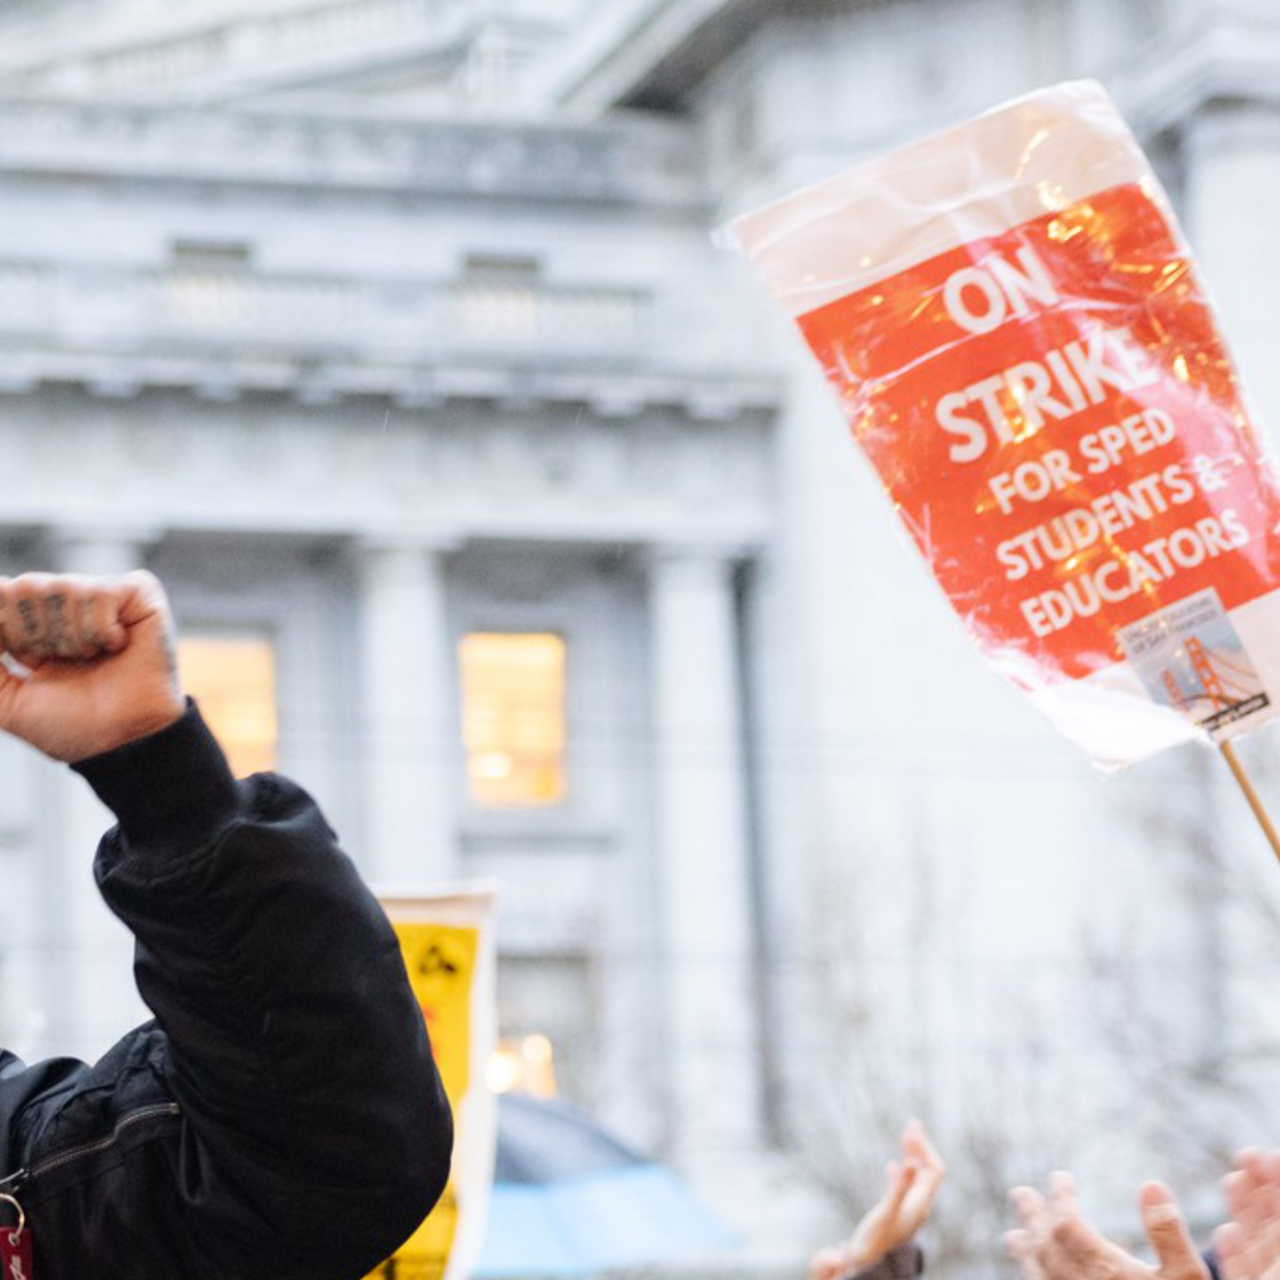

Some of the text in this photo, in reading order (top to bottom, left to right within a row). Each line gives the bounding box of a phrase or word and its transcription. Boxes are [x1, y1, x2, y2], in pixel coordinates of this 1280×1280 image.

[943, 245, 1058, 334] ON
[935, 325, 1158, 464] STRIKE
[987, 404, 1178, 517] FOR SPED
[995, 454, 1230, 582] STUDENTS &
[1018, 509, 1250, 639] EDUCATORS
